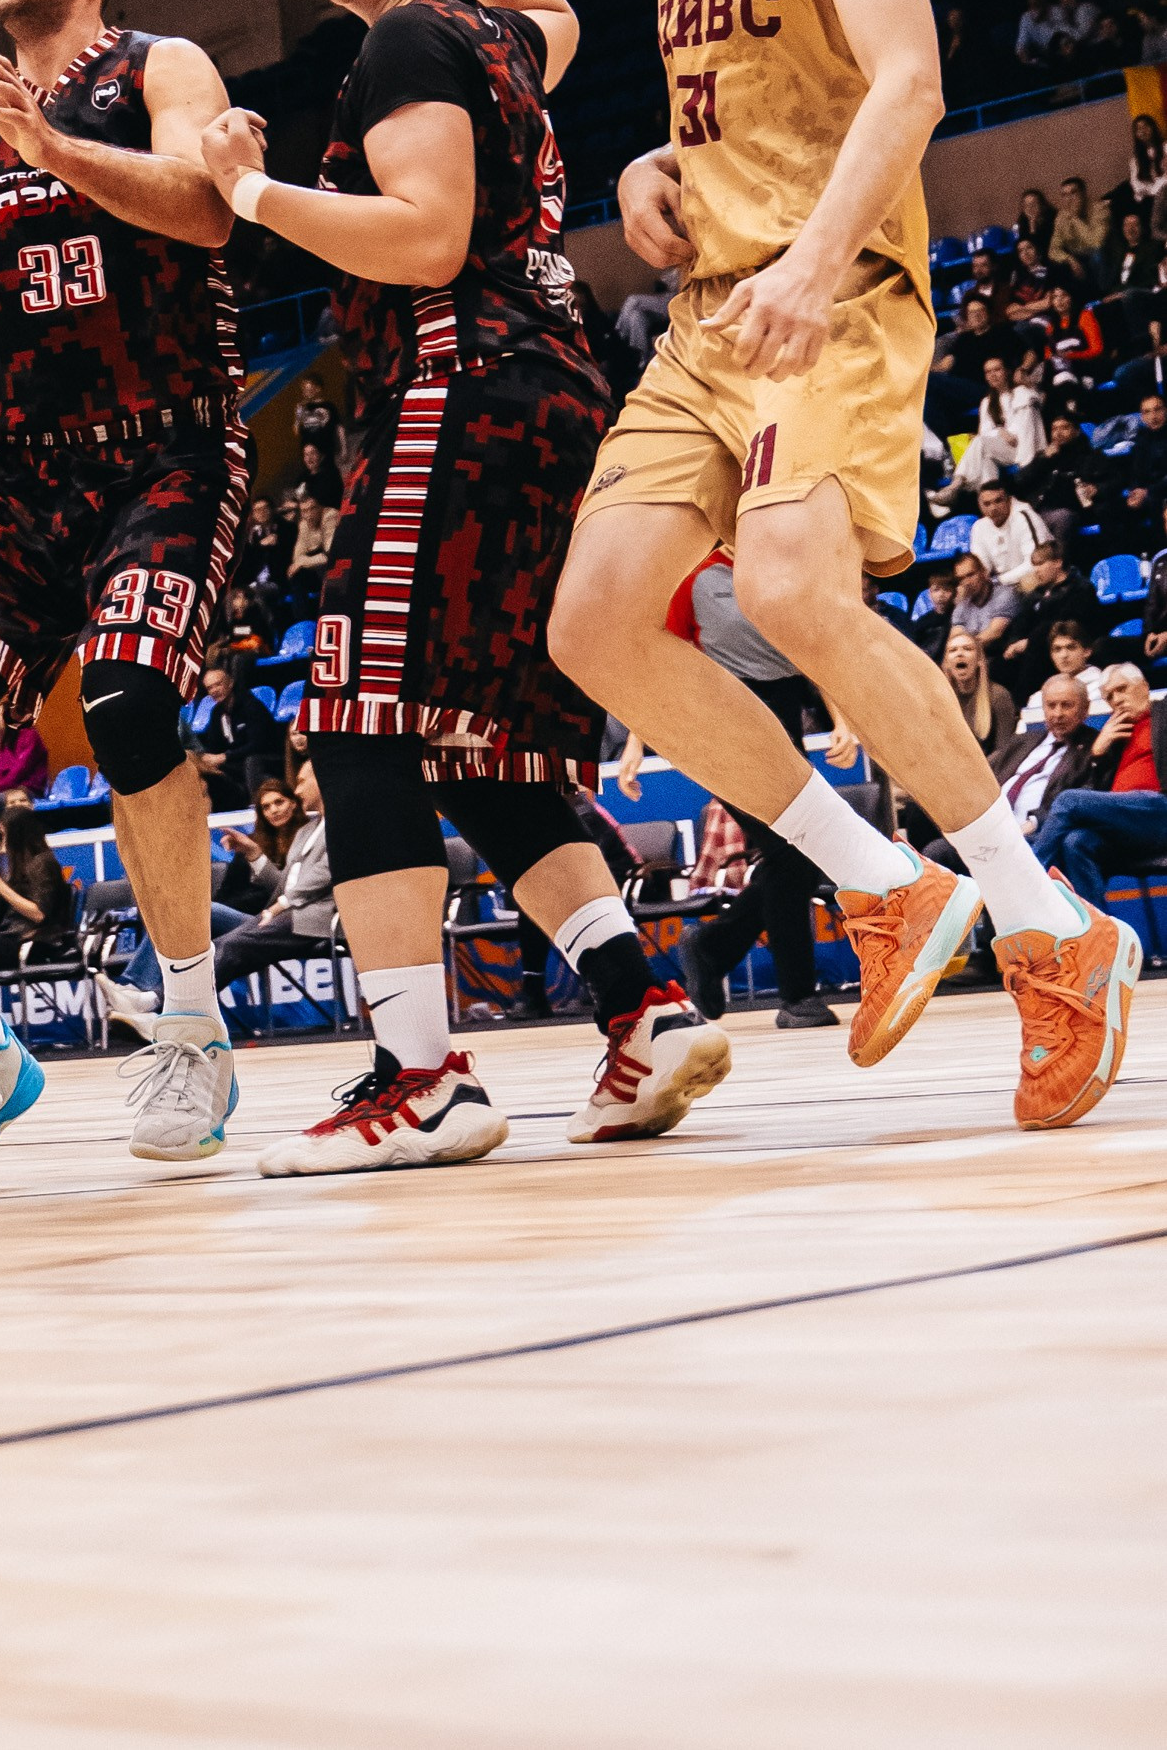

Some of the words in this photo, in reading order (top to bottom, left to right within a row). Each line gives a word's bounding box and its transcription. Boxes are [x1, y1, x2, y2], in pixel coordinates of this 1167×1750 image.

[676, 70, 722, 148] 31
[17, 234, 107, 314] 33
[97, 568, 197, 639] 33
[311, 614, 352, 688] 9
